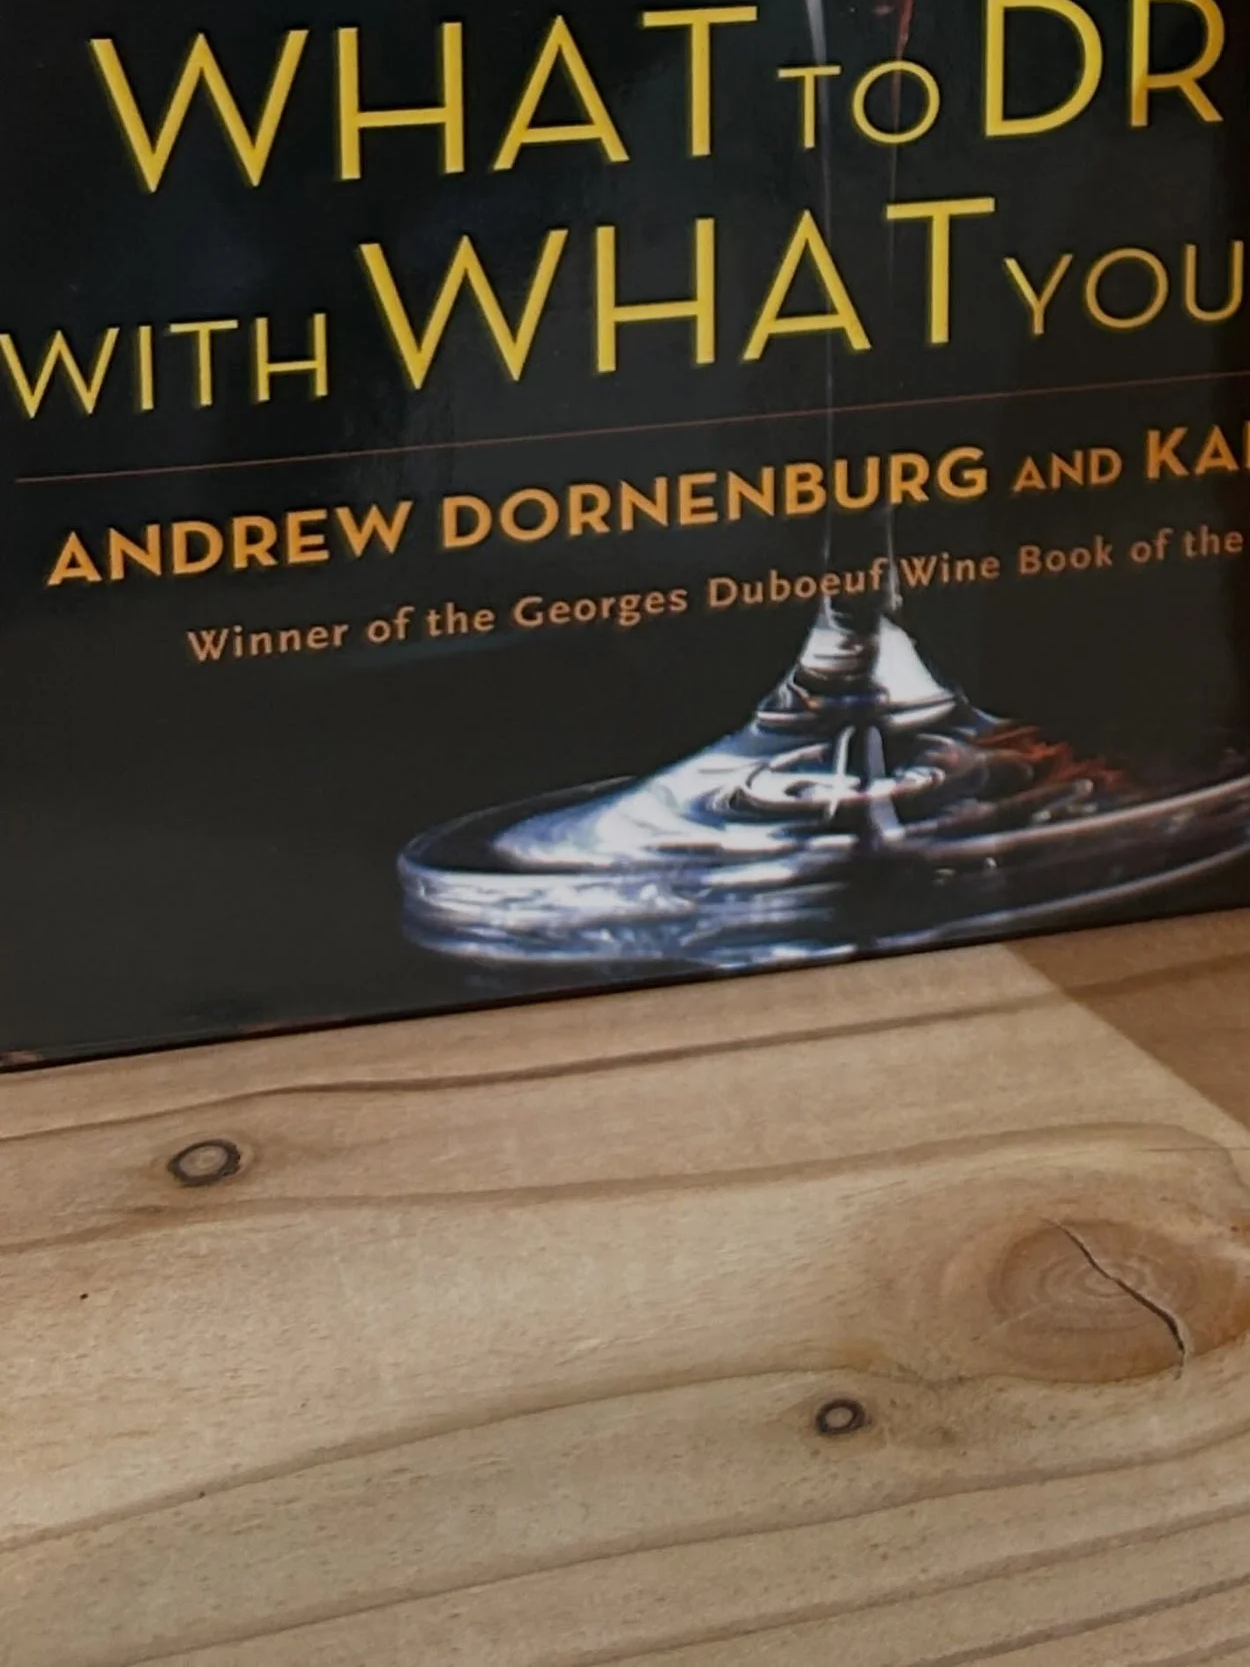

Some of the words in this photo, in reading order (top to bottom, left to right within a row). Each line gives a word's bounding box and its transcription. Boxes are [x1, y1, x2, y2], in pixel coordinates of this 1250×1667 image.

[90, 5, 758, 193] WHAT
[778, 60, 940, 150] TO
[0, 313, 330, 420] WITH
[358, 198, 996, 390] WHAT
[1004, 239, 1245, 336] YOU
[47, 501, 411, 587] ANDREW
[442, 447, 989, 549] DORNENBURG
[1012, 447, 1122, 495] AND
[188, 620, 350, 663] Winner
[367, 606, 410, 642] of
[426, 599, 496, 637] the
[512, 586, 688, 633] Georges
[707, 560, 887, 609] Duboeuf
[899, 552, 1001, 591] Wine
[1018, 537, 1114, 578] Book
[1130, 528, 1173, 562] of
[1184, 523, 1245, 558] the
